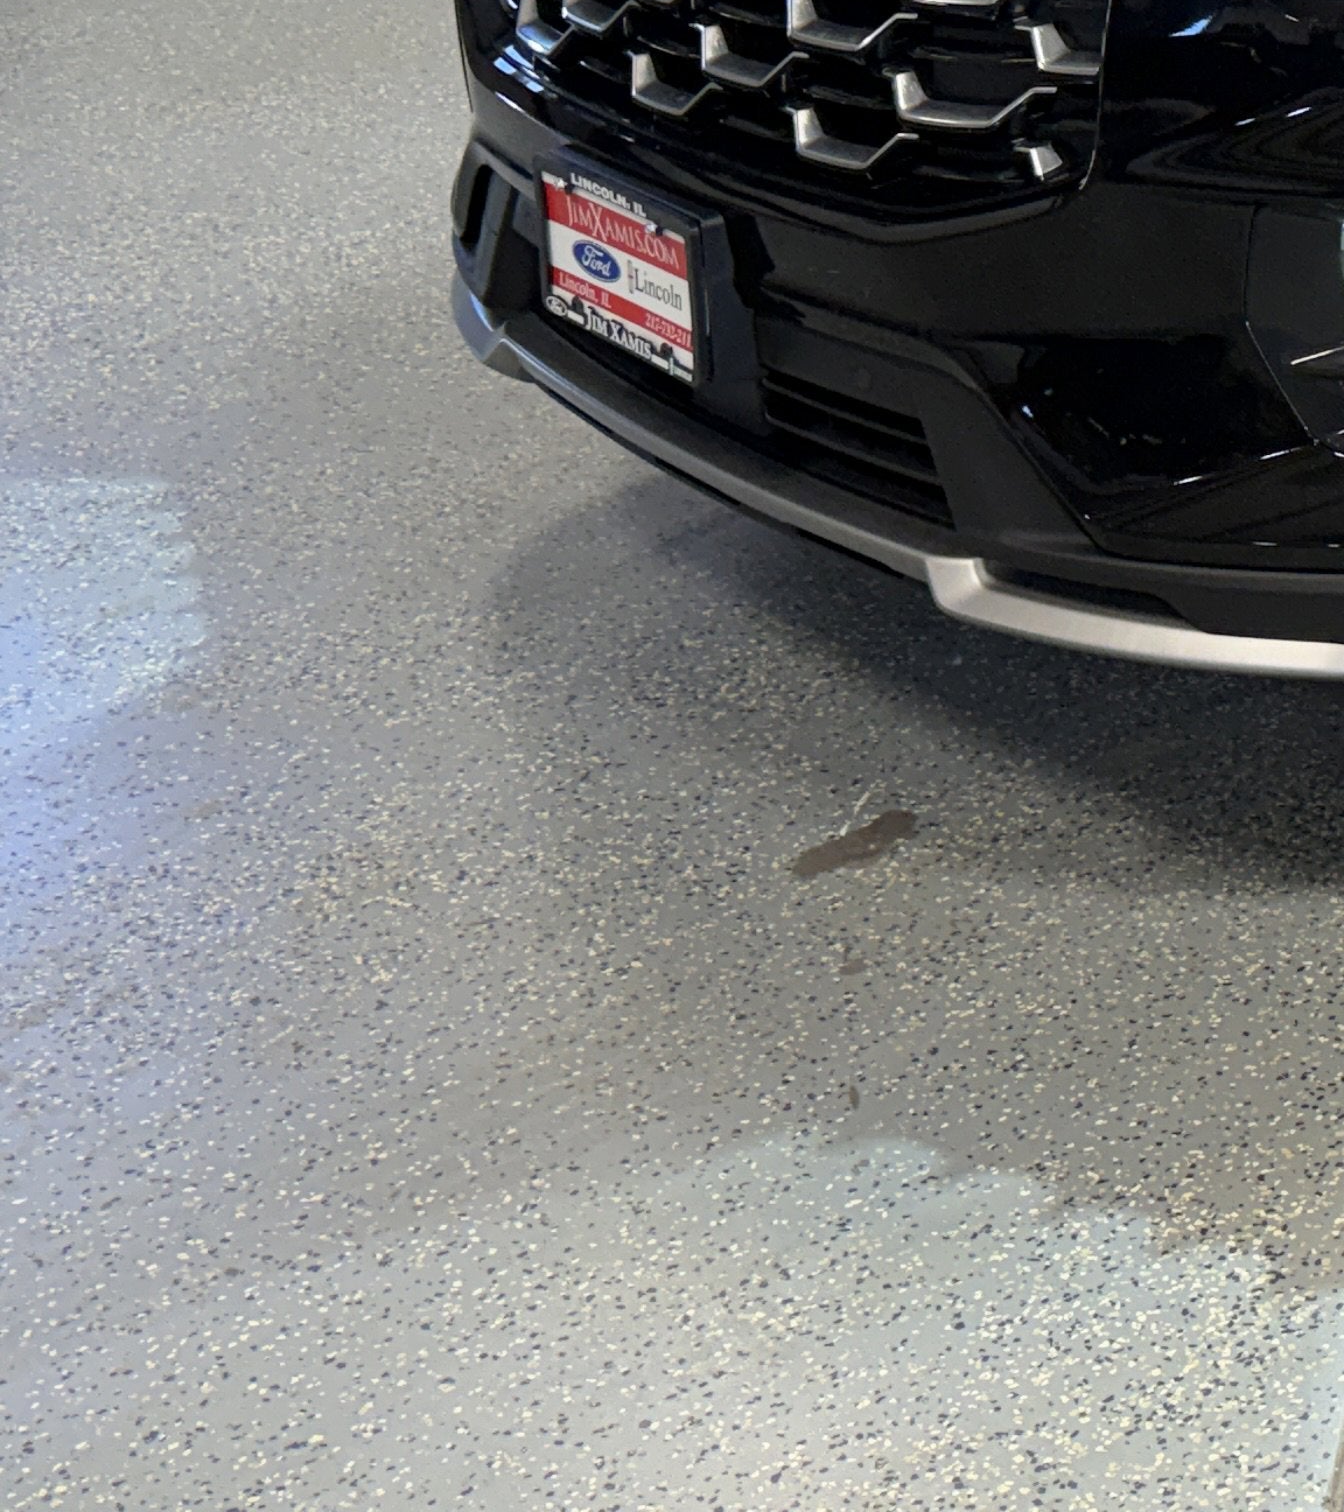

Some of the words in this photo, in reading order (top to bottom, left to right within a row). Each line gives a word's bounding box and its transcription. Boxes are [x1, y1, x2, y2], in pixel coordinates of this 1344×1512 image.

[632, 201, 647, 218] IL
[582, 245, 611, 277] Ford
[634, 268, 682, 311] Lincoln
